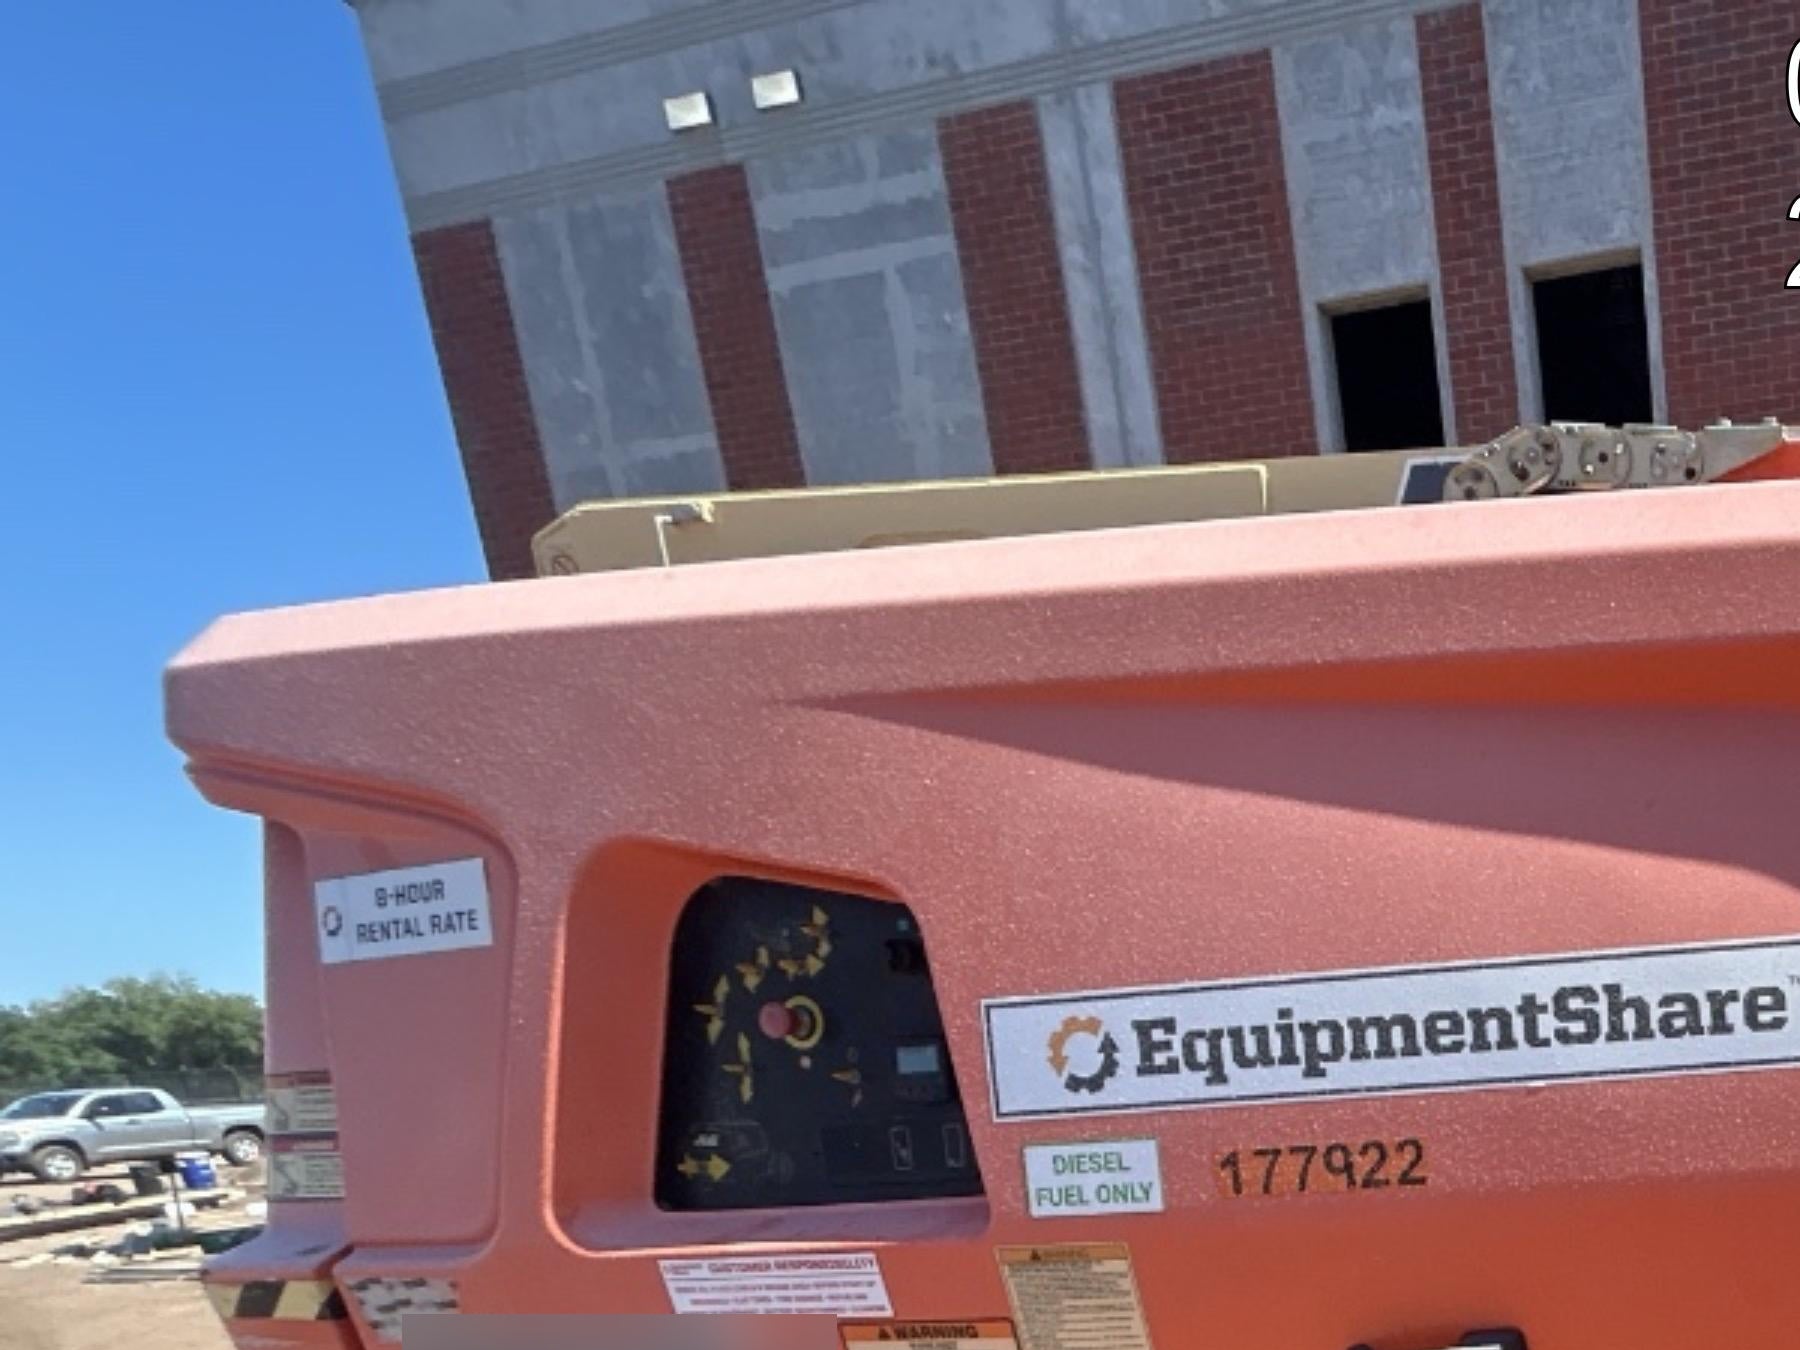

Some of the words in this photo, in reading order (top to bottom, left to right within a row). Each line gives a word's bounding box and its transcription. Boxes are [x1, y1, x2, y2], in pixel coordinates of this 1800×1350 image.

[374, 879, 446, 909] 8-HOUR
[355, 916, 425, 945] RENTAL
[429, 908, 480, 936] RATE
[1134, 982, 1789, 1083] EquipmentShare
[1052, 1151, 1131, 1176] DIESEL
[1219, 1139, 1428, 1196] 177922
[1035, 1184, 1087, 1207] FUEL
[1094, 1181, 1154, 1204] ONLY
[894, 1325, 979, 1340] WARNING
